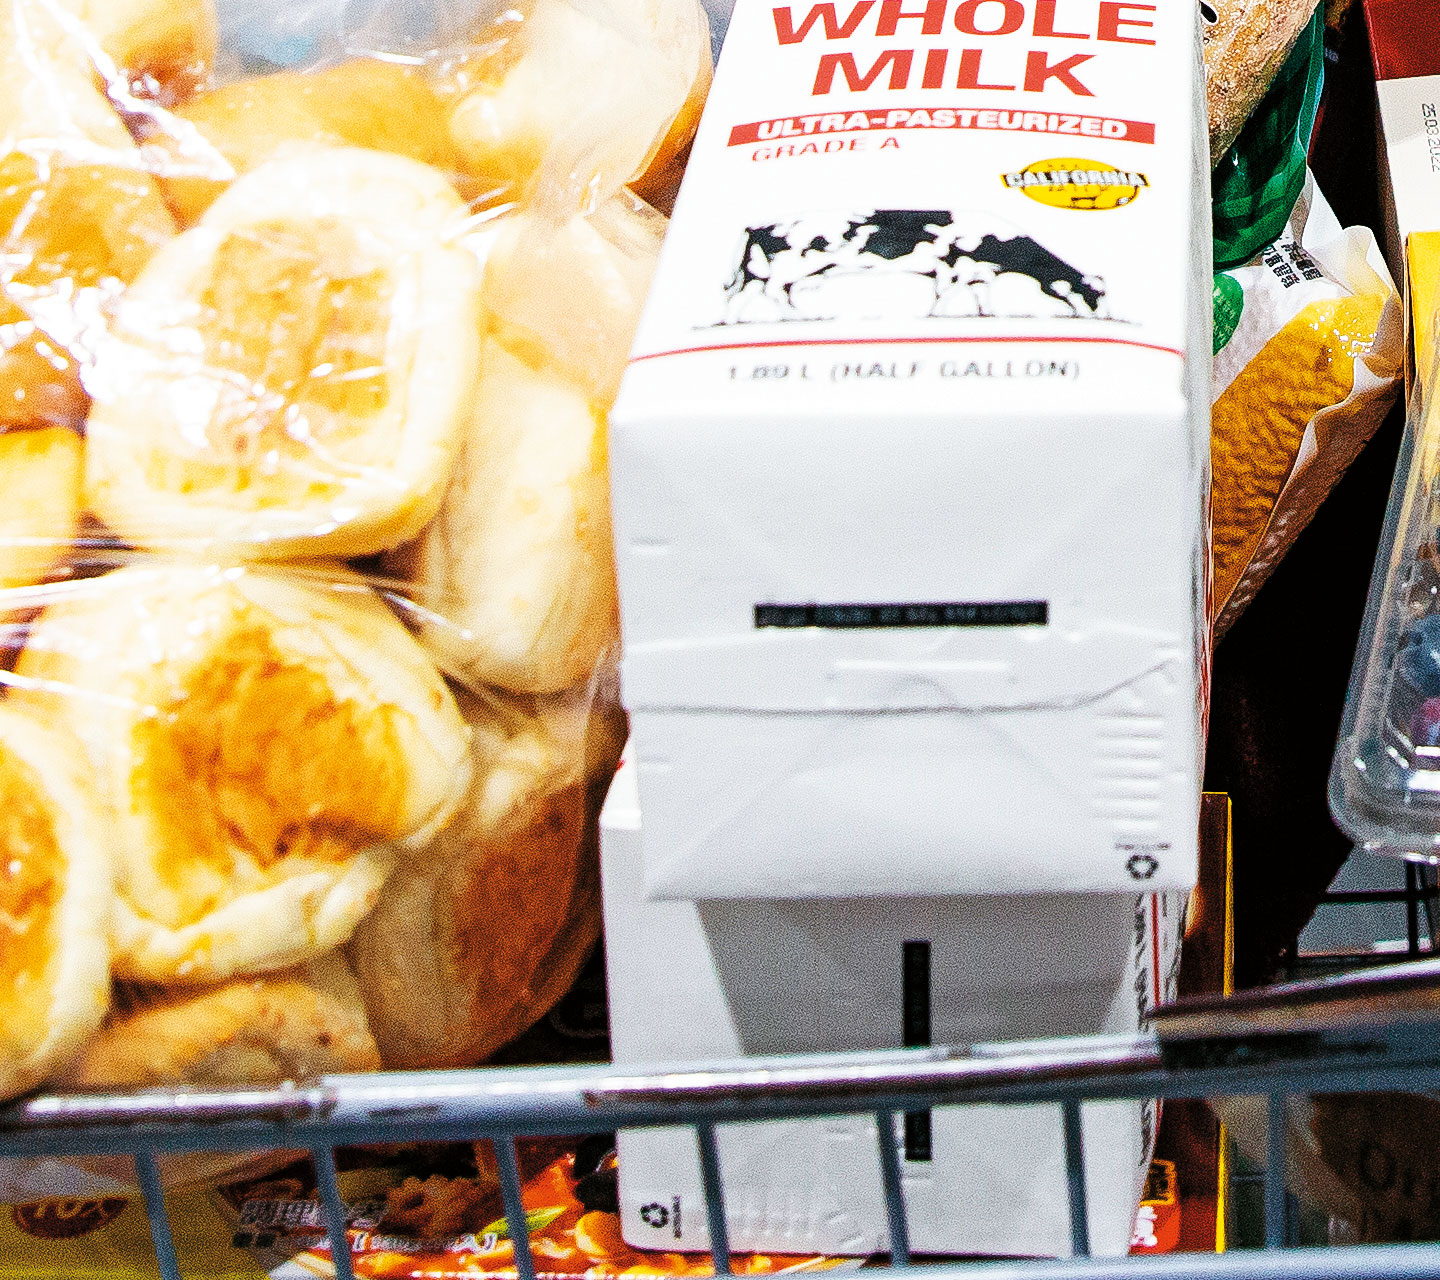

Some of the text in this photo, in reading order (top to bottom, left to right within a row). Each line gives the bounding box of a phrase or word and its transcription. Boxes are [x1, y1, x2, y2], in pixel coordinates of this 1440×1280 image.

[811, 48, 1096, 97] MILK
[756, 109, 1128, 139] ULTRA-PASTEURIZED
[752, 137, 901, 162] GRADE A
[1004, 171, 1148, 189] CALIFORNIA
[830, 360, 919, 382] (HALF
[940, 360, 1080, 381] GALLON)
